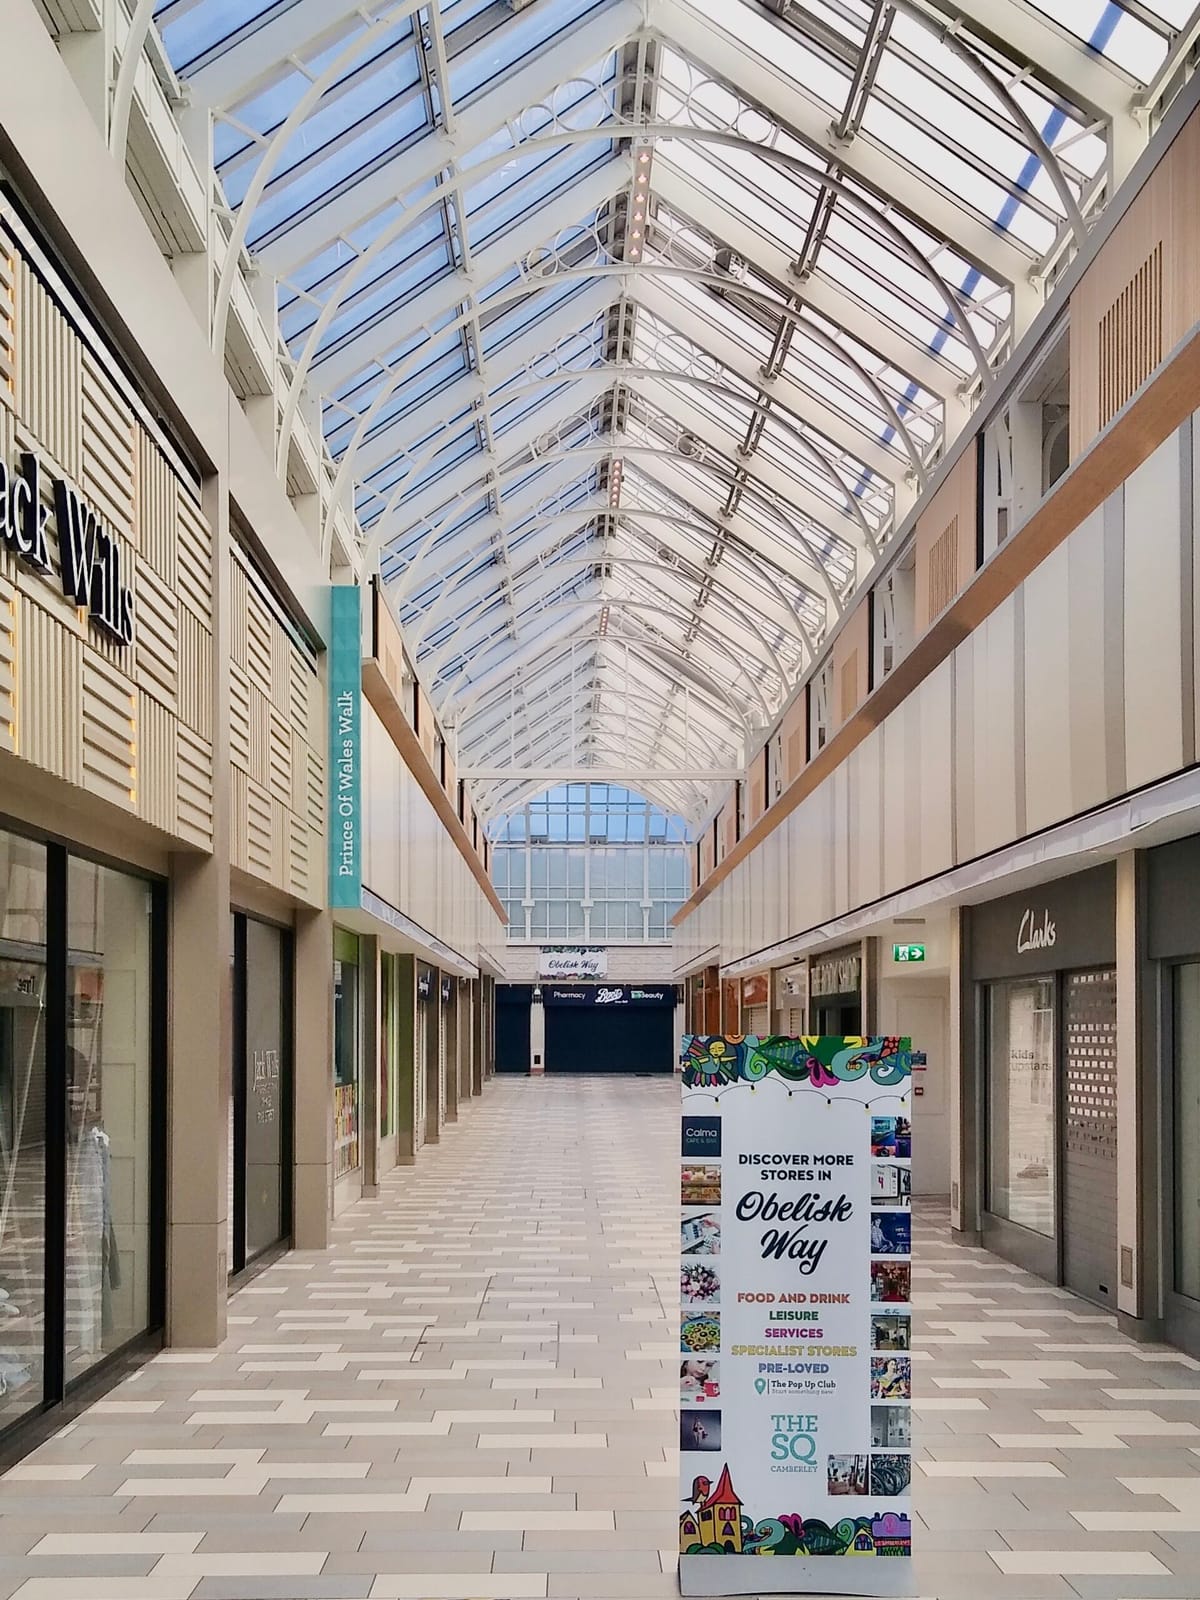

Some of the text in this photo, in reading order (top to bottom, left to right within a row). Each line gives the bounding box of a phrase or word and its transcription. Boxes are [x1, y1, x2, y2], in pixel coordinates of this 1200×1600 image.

[52, 479, 133, 646] Wills
[337, 691, 353, 876] Prince Of Wales Walk
[1018, 909, 1056, 953] Clarks
[548, 959, 599, 972] Obelisk Way
[553, 991, 586, 1000] Pharmacy
[595, 988, 623, 1004] Boots
[640, 991, 664, 1000] Beauty
[1011, 1049, 1034, 1060] kids
[686, 1128, 717, 1137] Calma
[739, 1154, 854, 1165] DISCOVER MORE
[761, 1170, 832, 1181] STORES IN
[736, 1191, 853, 1221] Obelisk
[761, 1224, 828, 1275] Way
[737, 1293, 850, 1304] FOOD AND DRINK
[769, 1311, 819, 1321] LEISURE
[765, 1328, 823, 1338] SERVICES
[731, 1345, 857, 1357] SPECIALIST STORES
[759, 1363, 829, 1374] PRE-LOVED
[771, 1380, 836, 1390] The Pop Up Club
[770, 1414, 818, 1432] THE
[770, 1433, 817, 1466] SQ
